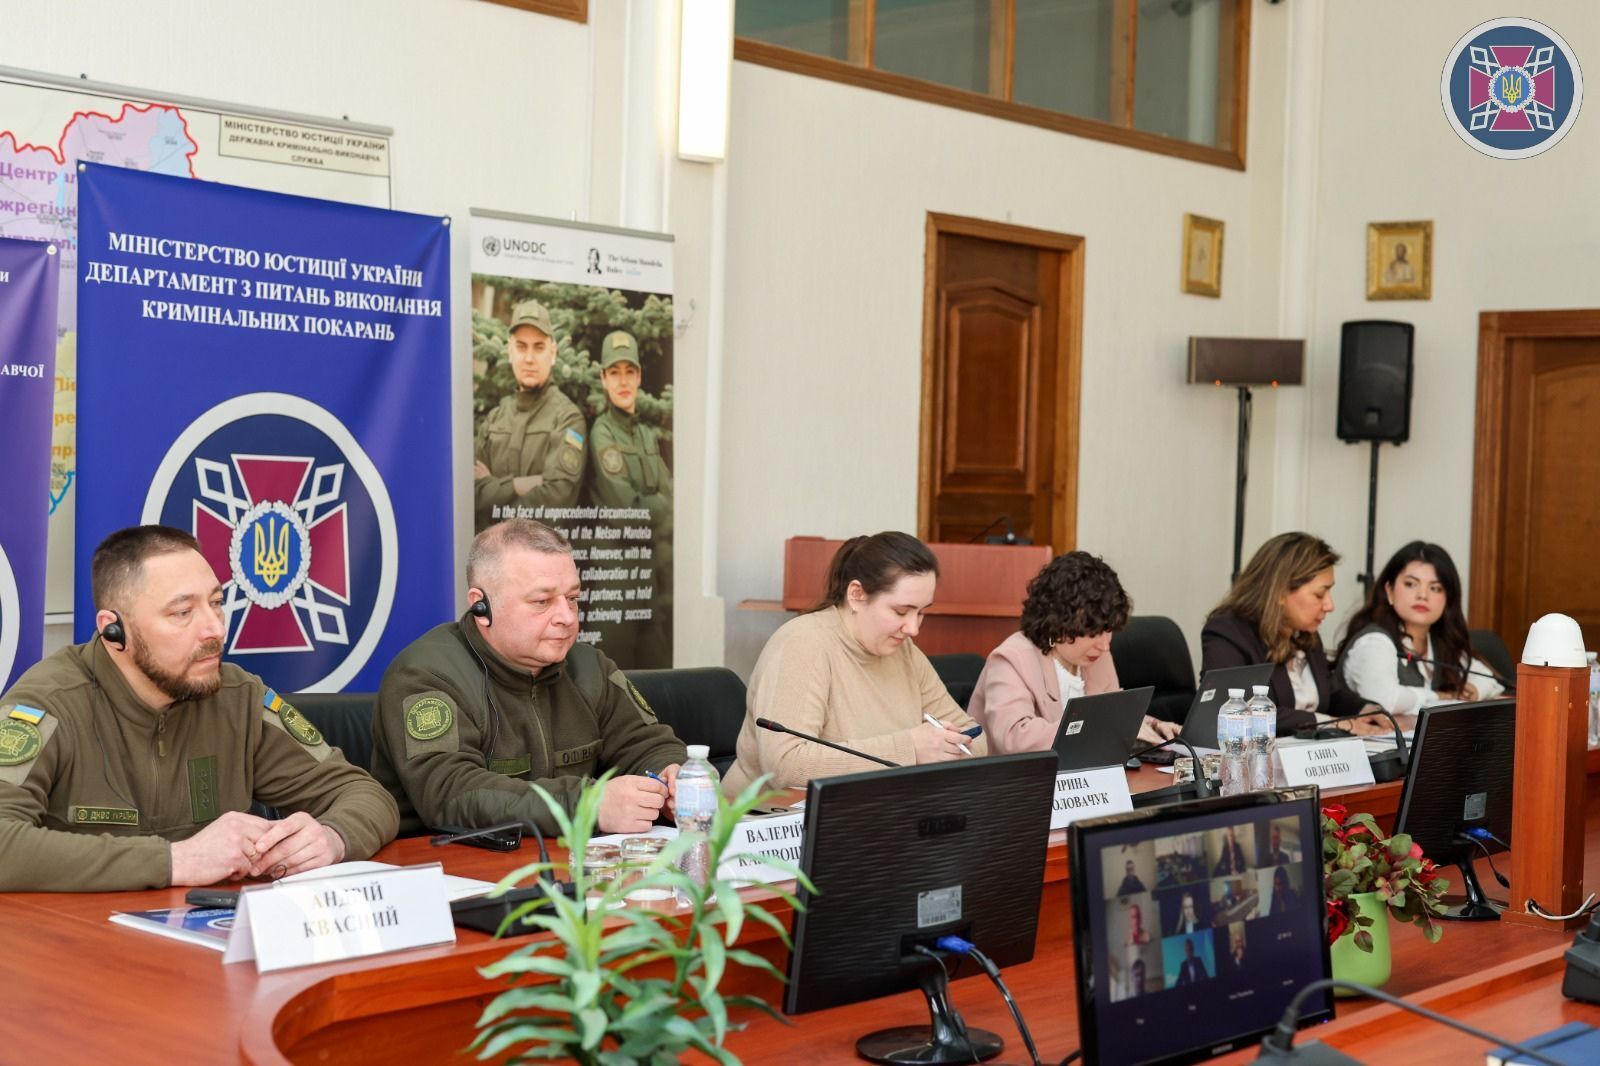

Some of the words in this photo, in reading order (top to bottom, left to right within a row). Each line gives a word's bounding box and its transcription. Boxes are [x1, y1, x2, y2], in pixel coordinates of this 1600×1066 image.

[224, 120, 299, 138] МІНІСТЕРСТВО
[301, 132, 344, 146] ЮСТИЦІЇ
[346, 139, 385, 151] УКРАЇНИ
[503, 238, 547, 255] UNODC
[108, 231, 261, 268] МІНІСТЕРСТВО
[263, 252, 347, 280] ЮСТИЦІЇ
[350, 264, 423, 288] УКРАЇНИ
[85, 261, 237, 296] ДЕПАРТАМЕНТ
[241, 280, 251, 298] З
[255, 281, 330, 306] ПИТАНЬ
[334, 290, 442, 317] ВИКОНАННЯ
[142, 299, 299, 333] КРИМІНАЛЬНИХ
[303, 315, 395, 341] ПОКАРАНЬ
[502, 505, 516, 518] the
[517, 505, 534, 518] face
[535, 505, 545, 518] of
[544, 504, 598, 521] unprecedented
[571, 526, 580, 539] of
[581, 526, 593, 539] the
[594, 526, 621, 539] Nelson
[623, 526, 652, 539] Mandela
[624, 546, 639, 559] with
[640, 546, 652, 559] the
[581, 566, 629, 580] collaboration
[630, 566, 639, 580] of
[640, 569, 652, 580] our
[625, 589, 636, 600] we
[636, 585, 653, 600] hold
[587, 607, 622, 624] achieving
[624, 609, 652, 620] success
[1056, 777, 1090, 791] ІРИНА
[1052, 792, 1110, 811] ОЛОВАЧУК
[746, 821, 804, 844] ВАЛЕРІЙ
